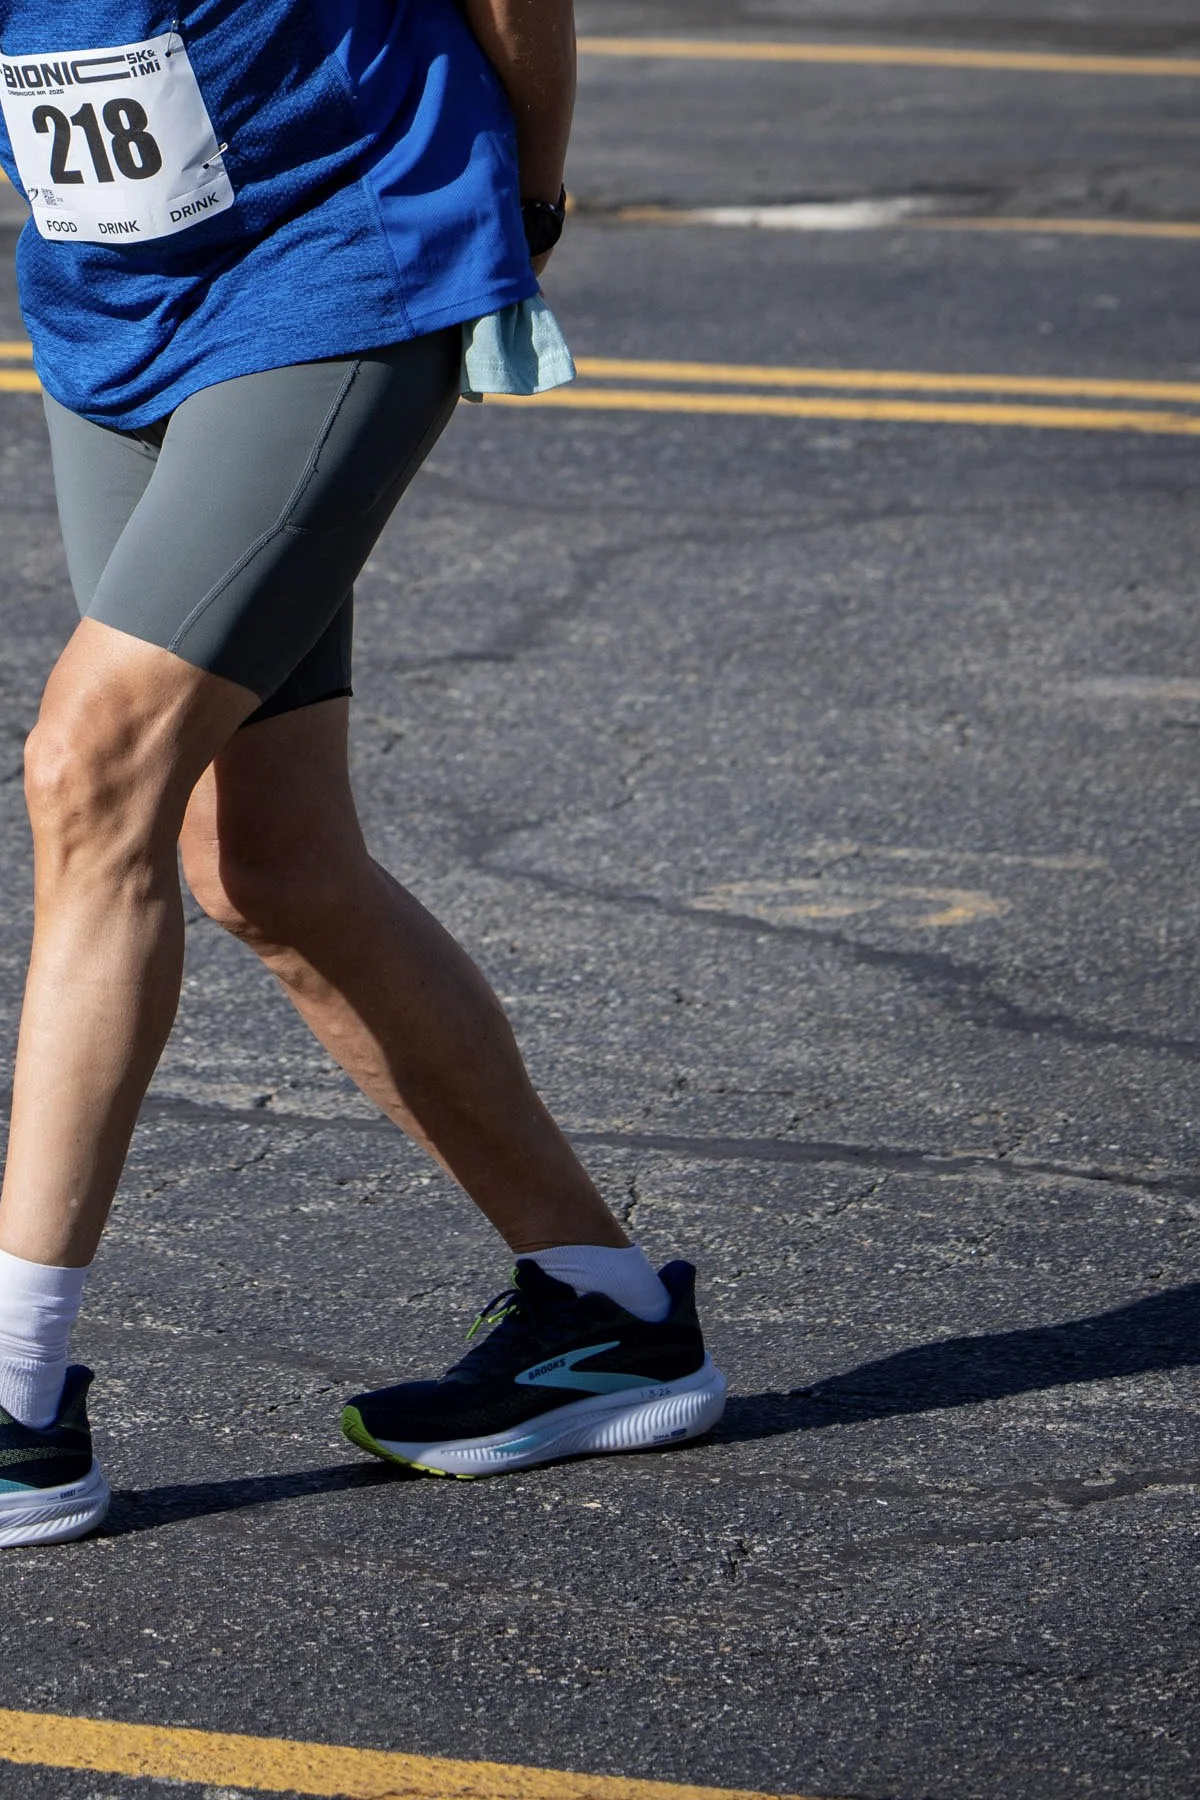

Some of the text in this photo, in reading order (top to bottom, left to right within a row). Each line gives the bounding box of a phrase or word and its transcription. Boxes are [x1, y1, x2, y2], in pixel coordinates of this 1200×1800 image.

[2, 54, 132, 89] BIONIC
[32, 97, 162, 185] 218
[46, 191, 220, 235] FOOD DRINK DRINK
[529, 1358, 566, 1380] BROOKS
